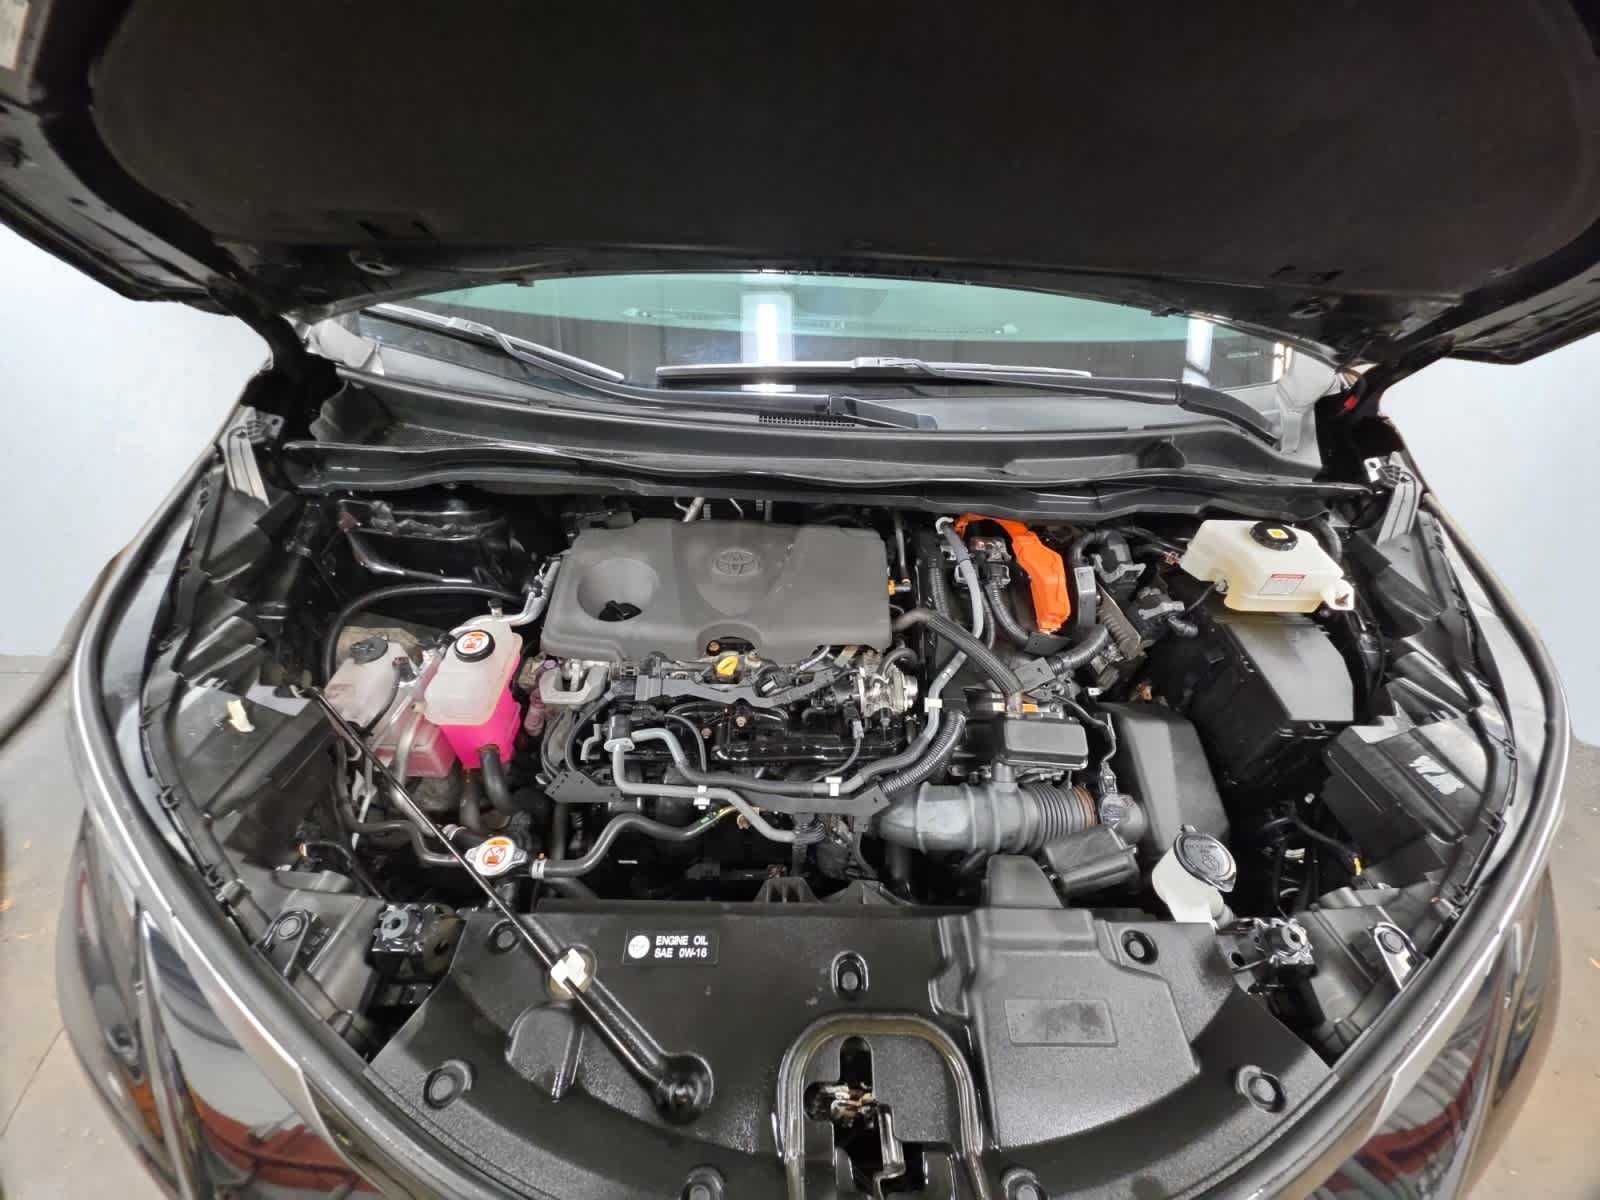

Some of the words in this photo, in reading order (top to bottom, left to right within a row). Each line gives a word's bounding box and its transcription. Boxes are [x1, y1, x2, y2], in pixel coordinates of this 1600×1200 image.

[655, 935, 689, 946] ENGINE
[693, 935, 709, 946] OIL
[654, 947, 674, 958] SAE
[679, 947, 708, 958] 0W-16
